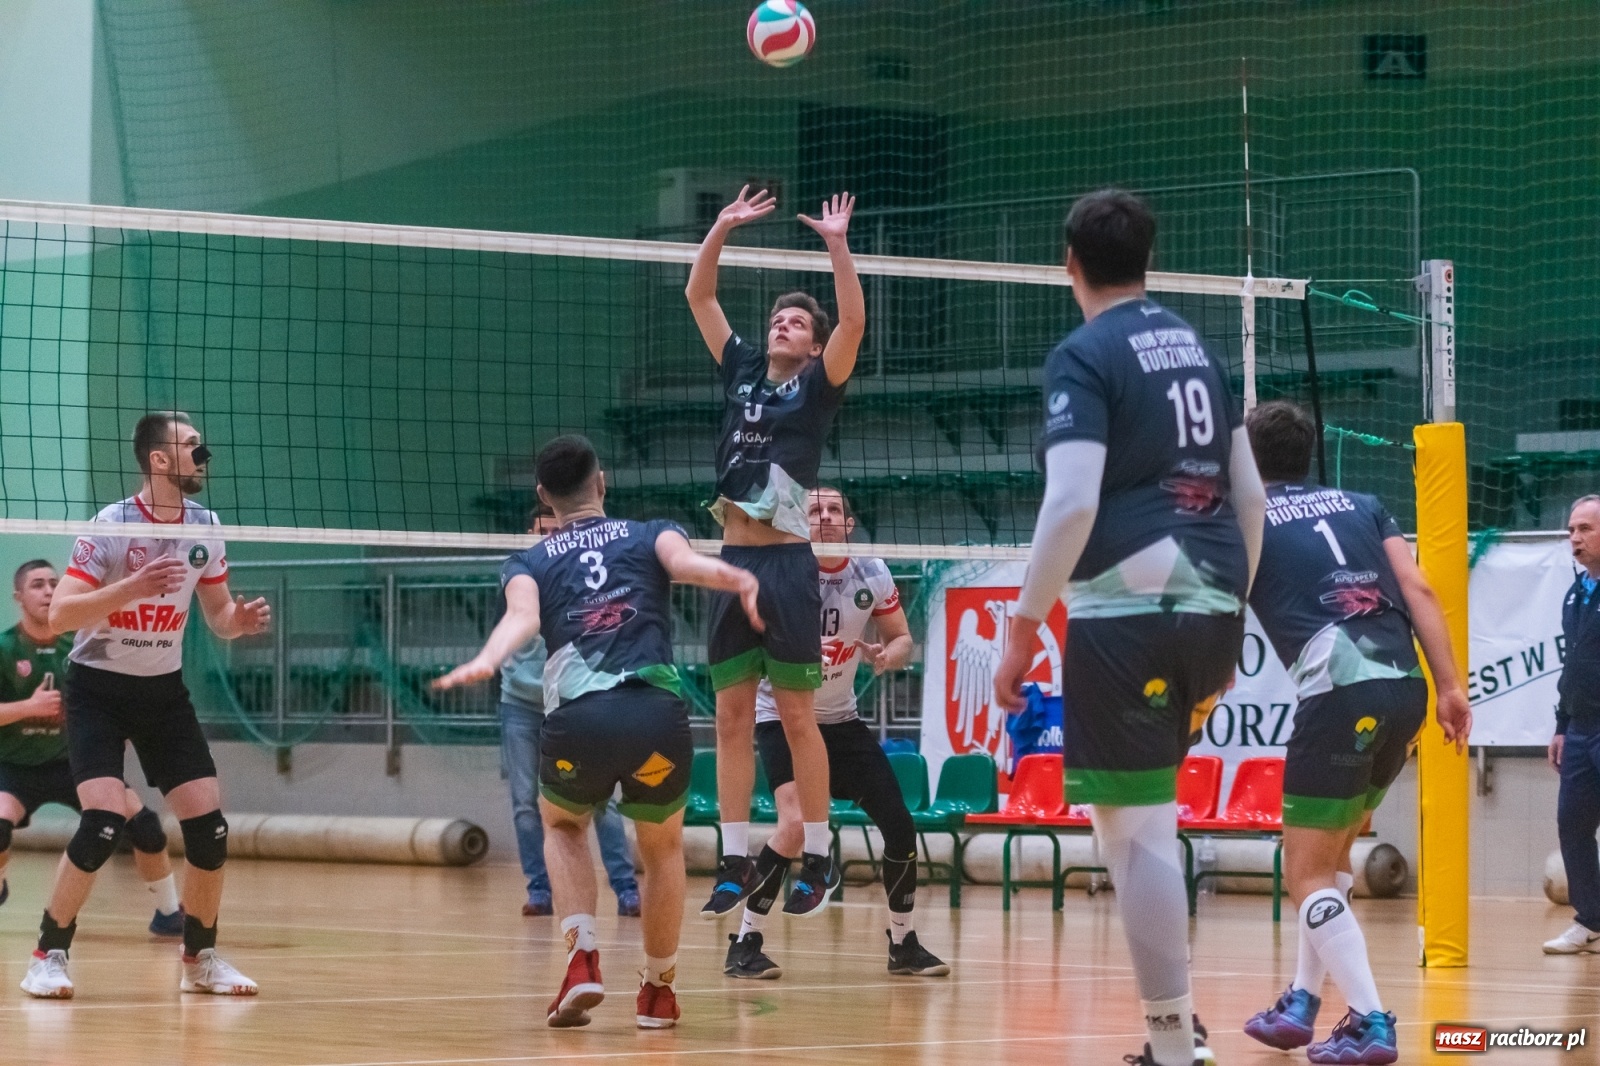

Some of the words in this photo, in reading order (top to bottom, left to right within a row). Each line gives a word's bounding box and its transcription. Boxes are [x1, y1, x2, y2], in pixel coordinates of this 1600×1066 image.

[1166, 378, 1214, 448] 19
[1289, 490, 1344, 505] SPORTOWY
[1266, 498, 1355, 527] RUDZINIEC
[545, 532, 571, 547] KLUB
[1313, 519, 1347, 566] 1
[579, 550, 608, 590] 3
[821, 608, 839, 637] 13
